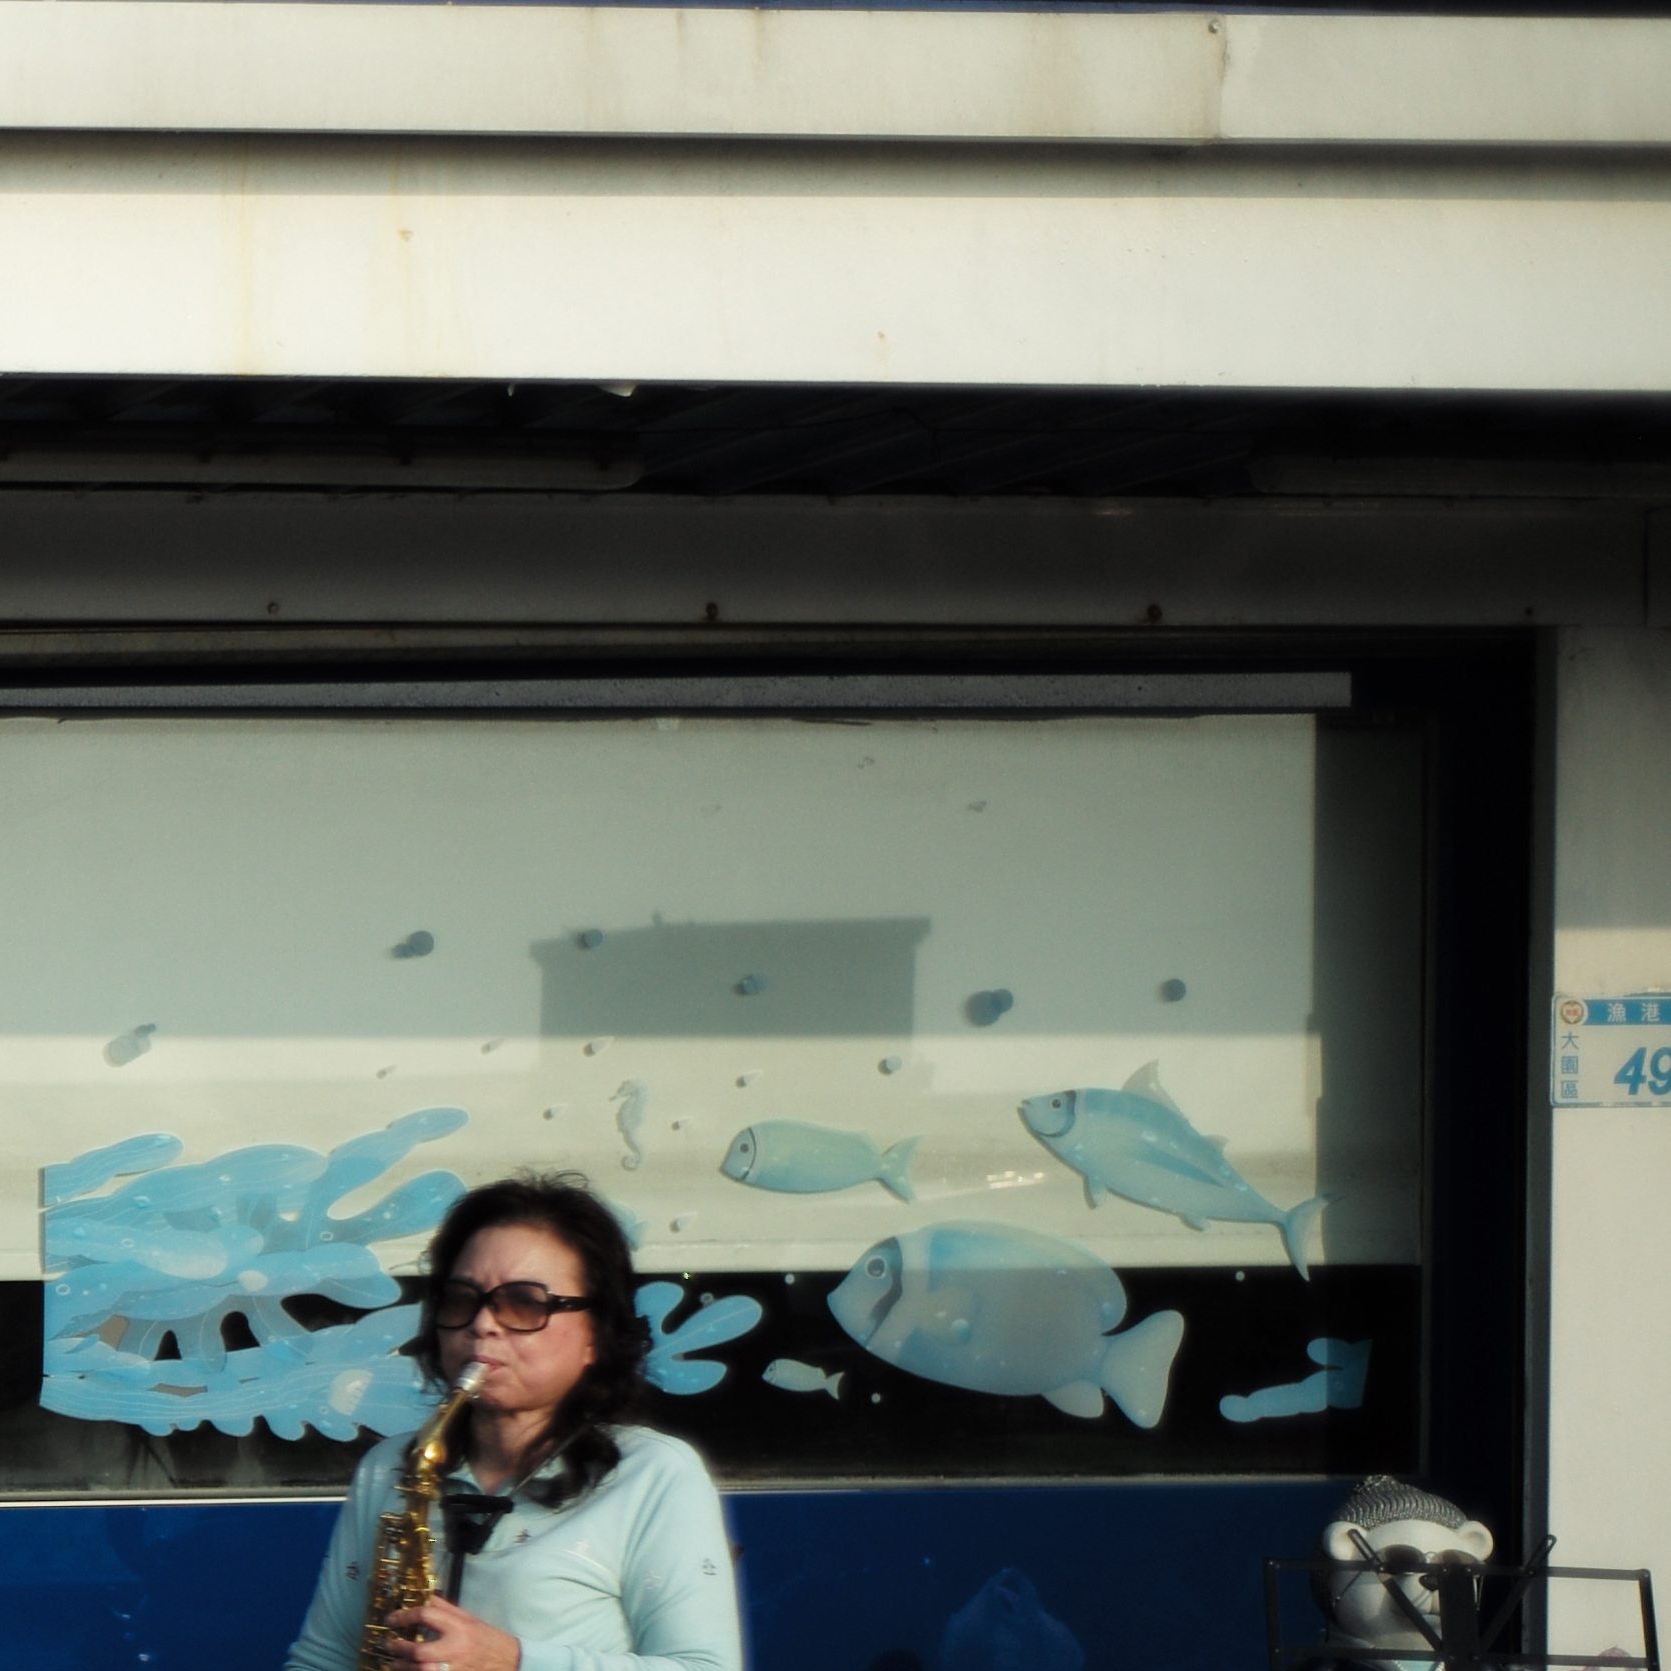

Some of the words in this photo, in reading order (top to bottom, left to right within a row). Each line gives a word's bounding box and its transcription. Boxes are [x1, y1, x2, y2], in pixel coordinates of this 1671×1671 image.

[1607, 1002, 1661, 1022] 漁港
[1561, 1031, 1579, 1098] 大園區
